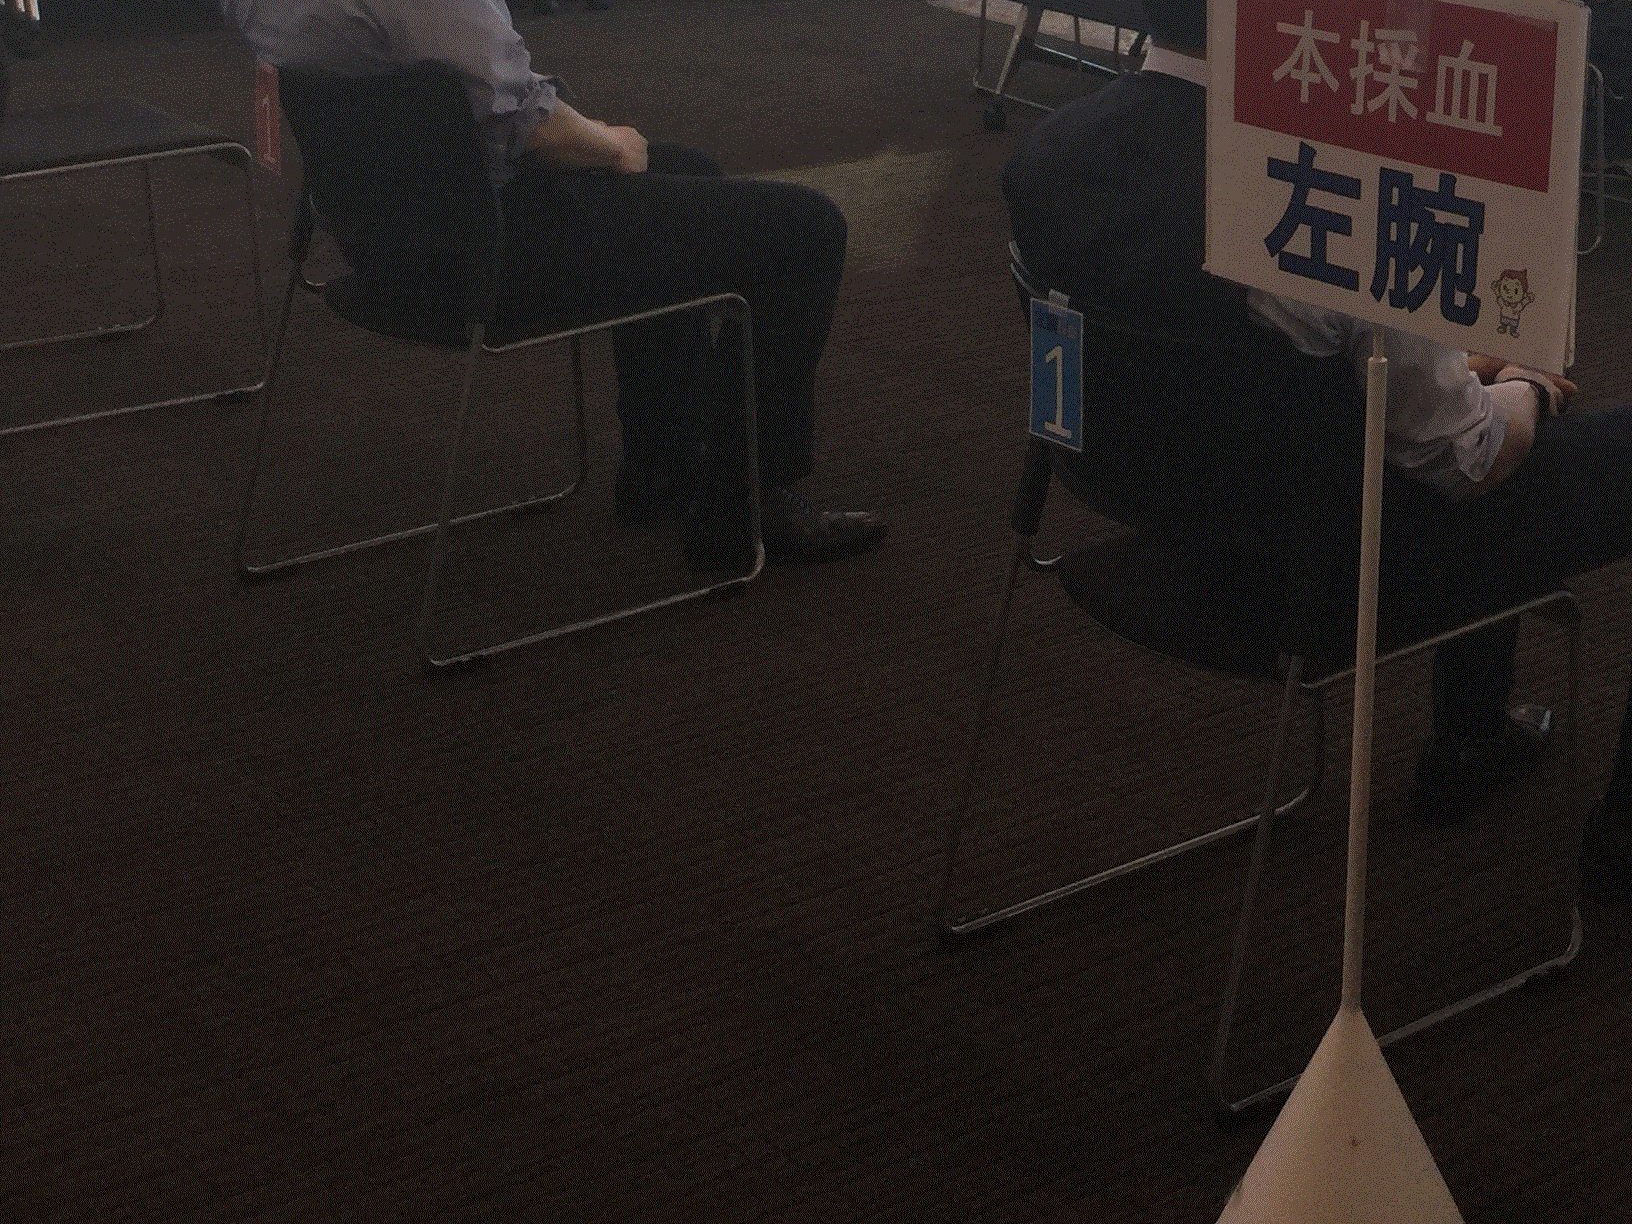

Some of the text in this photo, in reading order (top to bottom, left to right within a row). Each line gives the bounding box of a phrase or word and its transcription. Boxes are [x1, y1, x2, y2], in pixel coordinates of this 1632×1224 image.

[1272, 9, 1504, 139] 本採血
[1263, 141, 1486, 328] 左腕
[1043, 344, 1073, 440] 1
